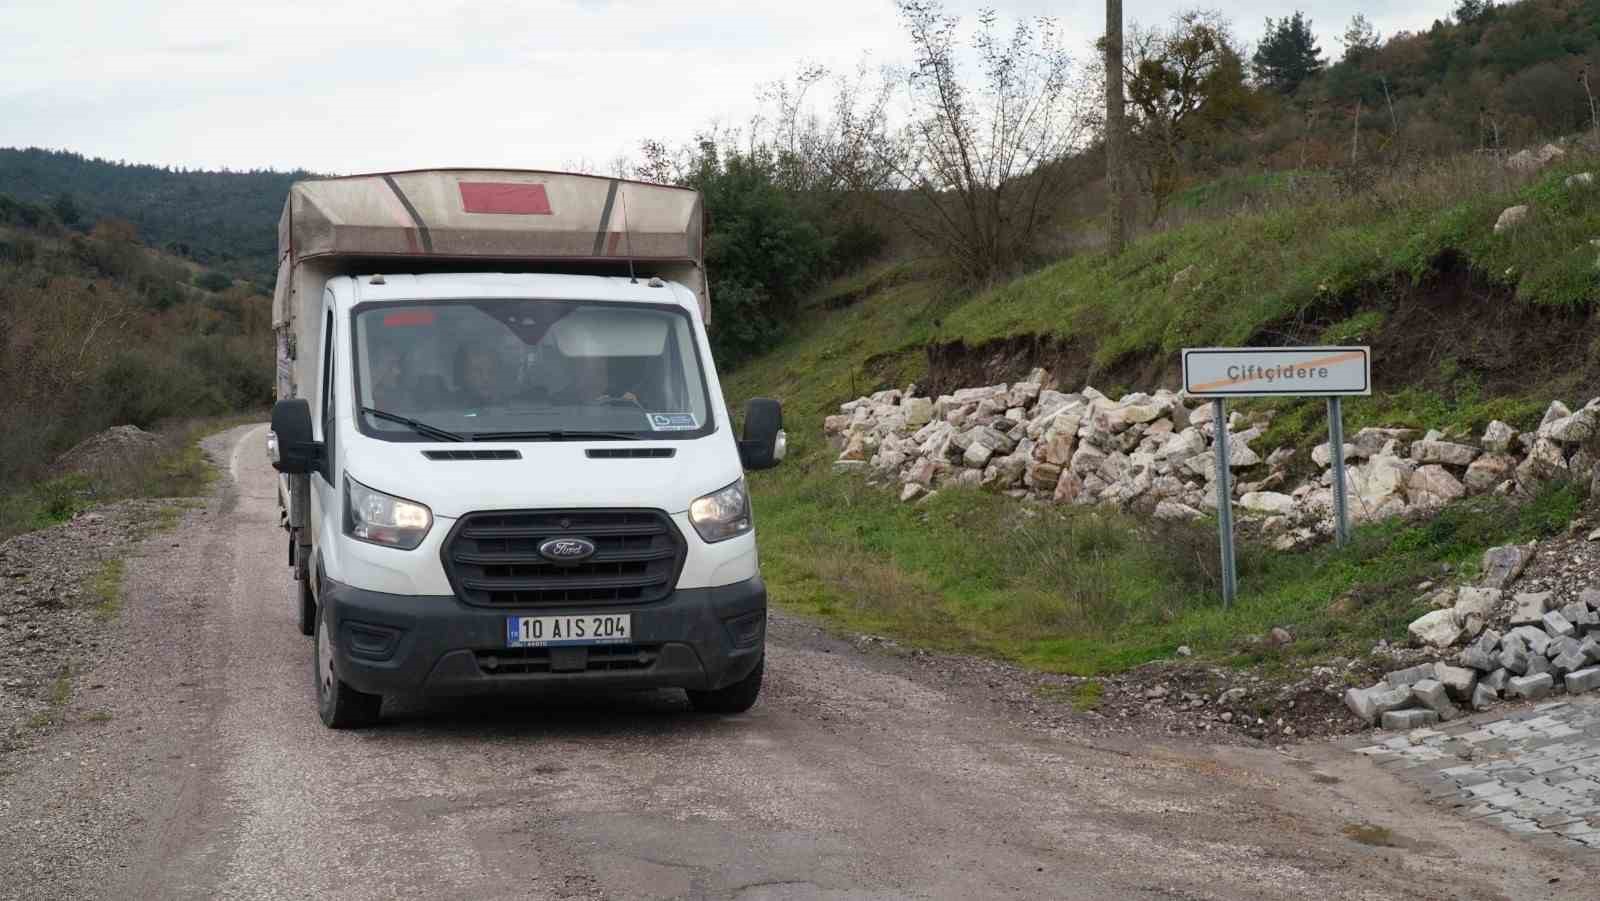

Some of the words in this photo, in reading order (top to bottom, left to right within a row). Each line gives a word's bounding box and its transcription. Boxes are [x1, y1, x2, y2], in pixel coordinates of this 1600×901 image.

[1227, 364, 1329, 383] Çiftçidere
[552, 542, 583, 554] Ford
[522, 619, 543, 639] 10
[552, 618, 585, 638] AIS
[593, 617, 625, 637] 204
